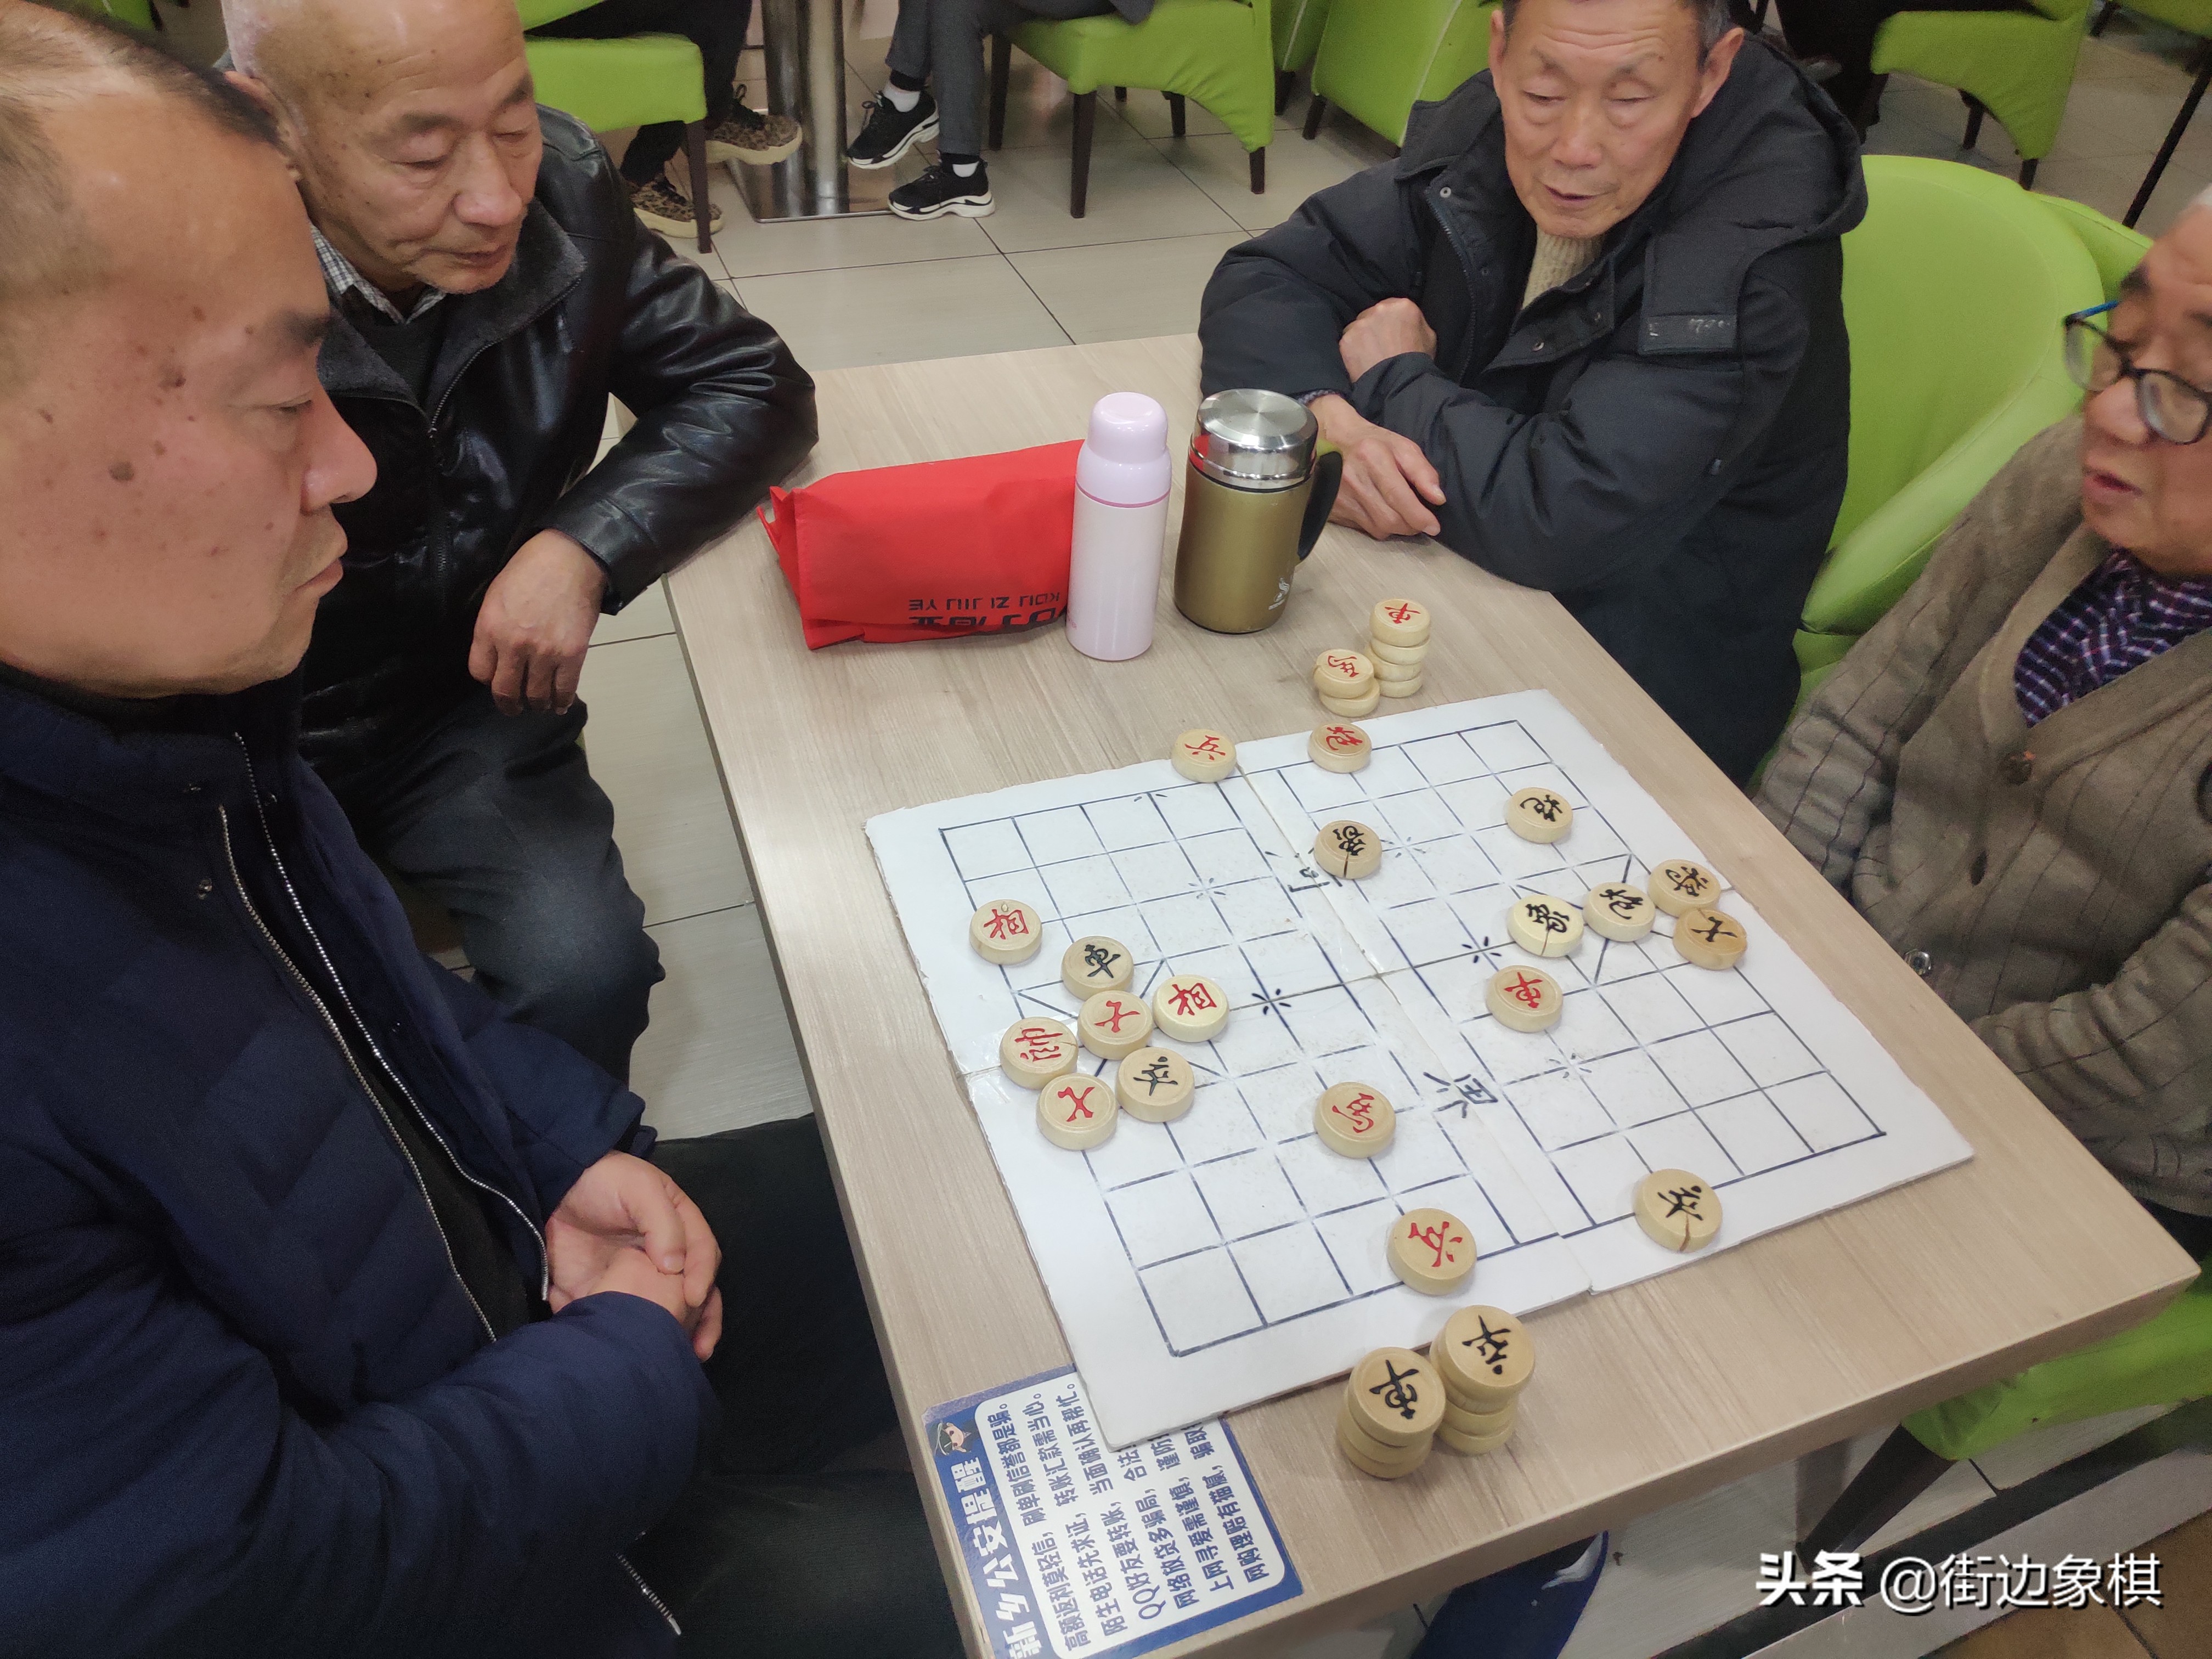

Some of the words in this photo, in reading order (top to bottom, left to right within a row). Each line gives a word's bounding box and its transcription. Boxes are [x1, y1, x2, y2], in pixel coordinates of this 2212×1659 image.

[909, 599, 938, 611] YE
[946, 597, 983, 611] JIU
[991, 596, 1011, 610] ZI
[1184, 734, 1226, 761] 兵
[1333, 825, 1367, 857] 象
[984, 909, 1029, 940] 相
[1085, 945, 1120, 978] 車
[1168, 983, 1217, 1016] 相
[1505, 973, 1541, 1008] 車
[1133, 1056, 1178, 1096] 卒
[1333, 1094, 1373, 1133] 馬
[1658, 1186, 1702, 1220] 卒
[1409, 1222, 1462, 1267] 兵
[1463, 1317, 1510, 1374] 卒
[1369, 1360, 1419, 1419] 車
[1147, 1433, 1235, 1593] 上网寻爱需谨慎，谨防
[1181, 1422, 1270, 1583] 网购理赔有猫腻，骗取
[1116, 1444, 1200, 1610] 网络放贷多骗局，合法
[950, 1457, 1042, 1659] 新乡公安提醒
